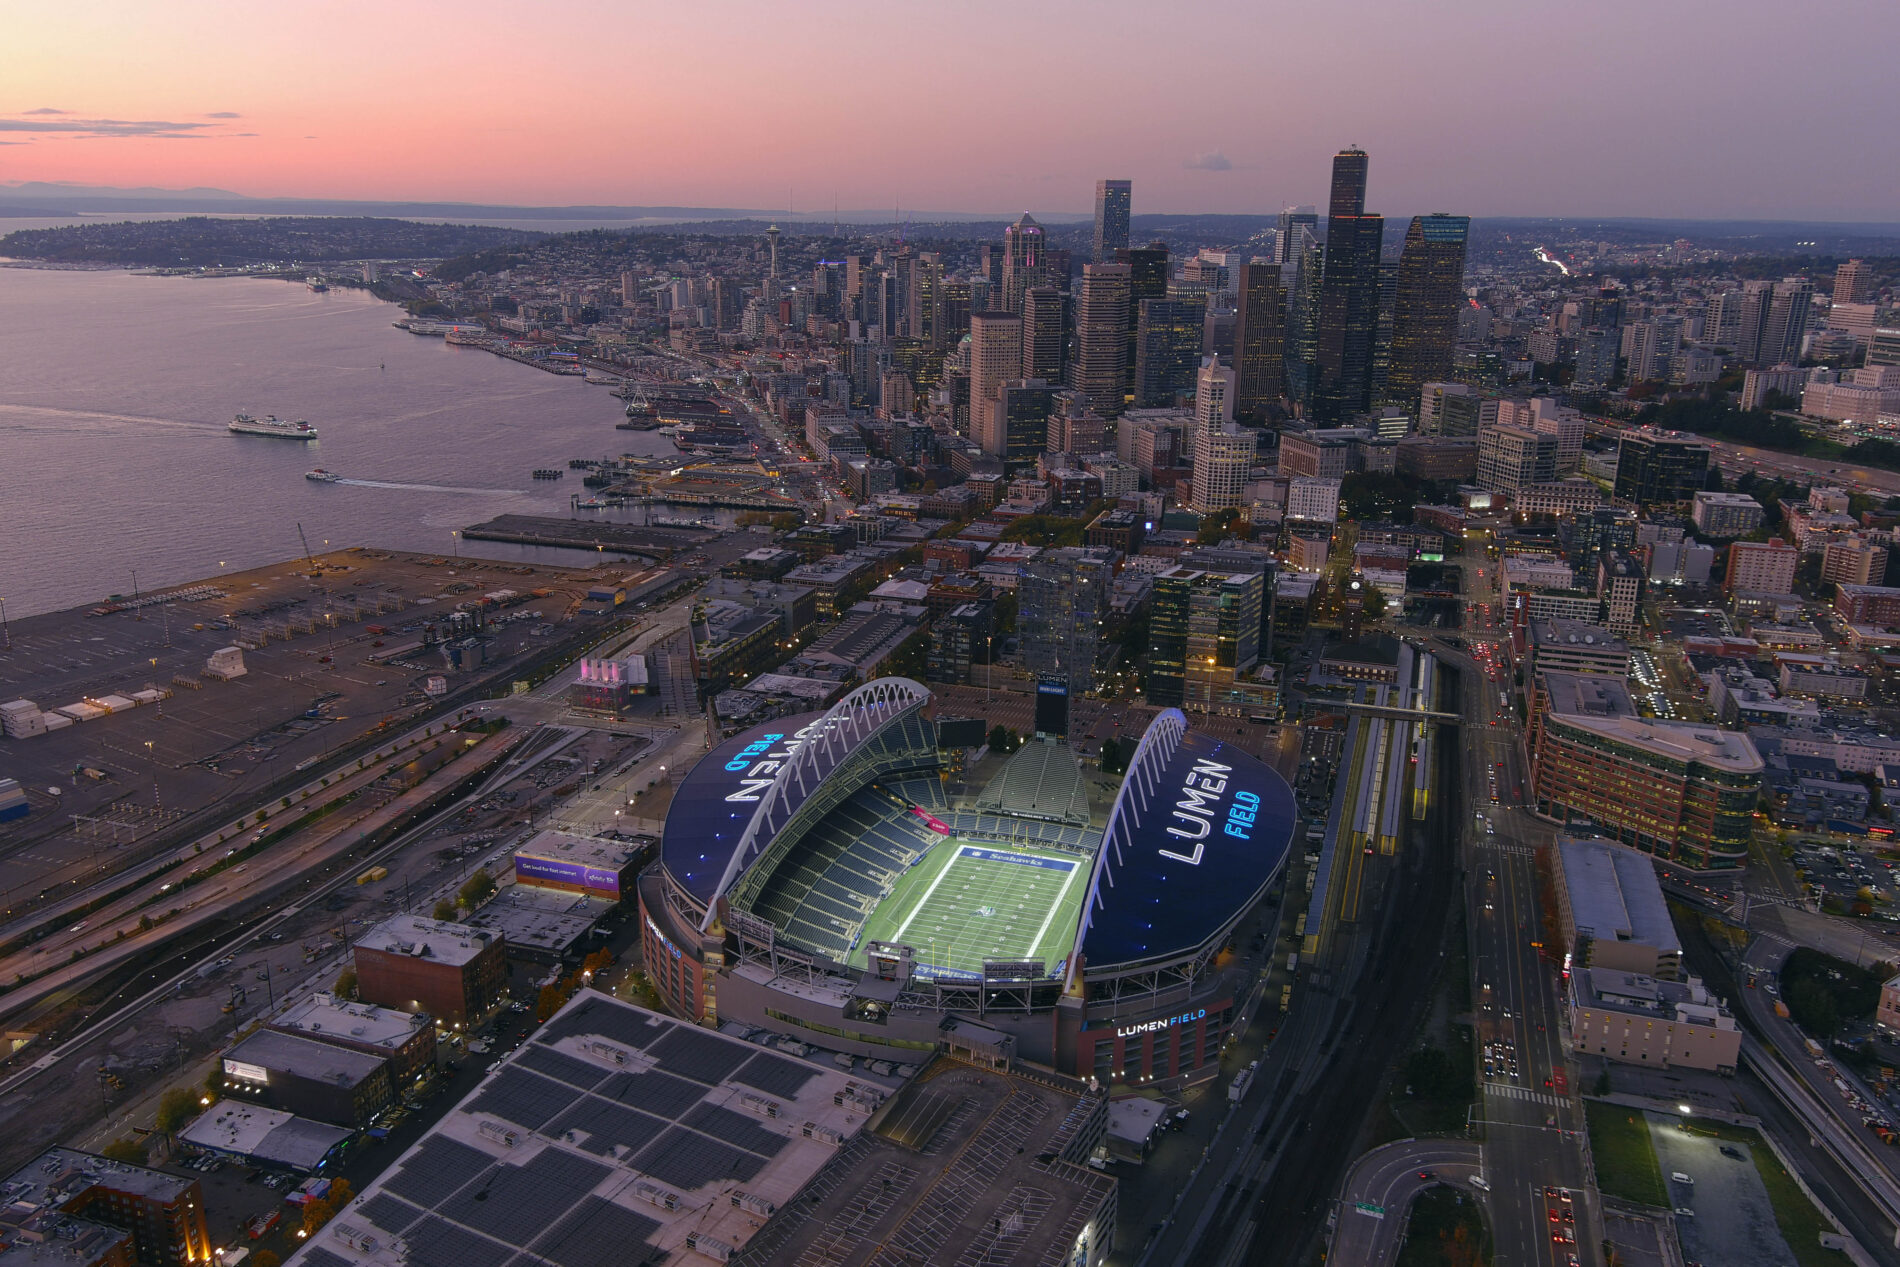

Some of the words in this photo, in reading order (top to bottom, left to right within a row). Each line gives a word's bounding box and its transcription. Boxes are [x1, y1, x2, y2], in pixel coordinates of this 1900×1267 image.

[724, 733, 784, 771] FIELD
[1158, 758, 1233, 865] LUMEN
[1224, 791, 1260, 840] FIELD
[989, 853, 1044, 866] Seahawks
[1117, 1018, 1168, 1037] LUMEN
[1170, 1008, 1206, 1026] FIELD
